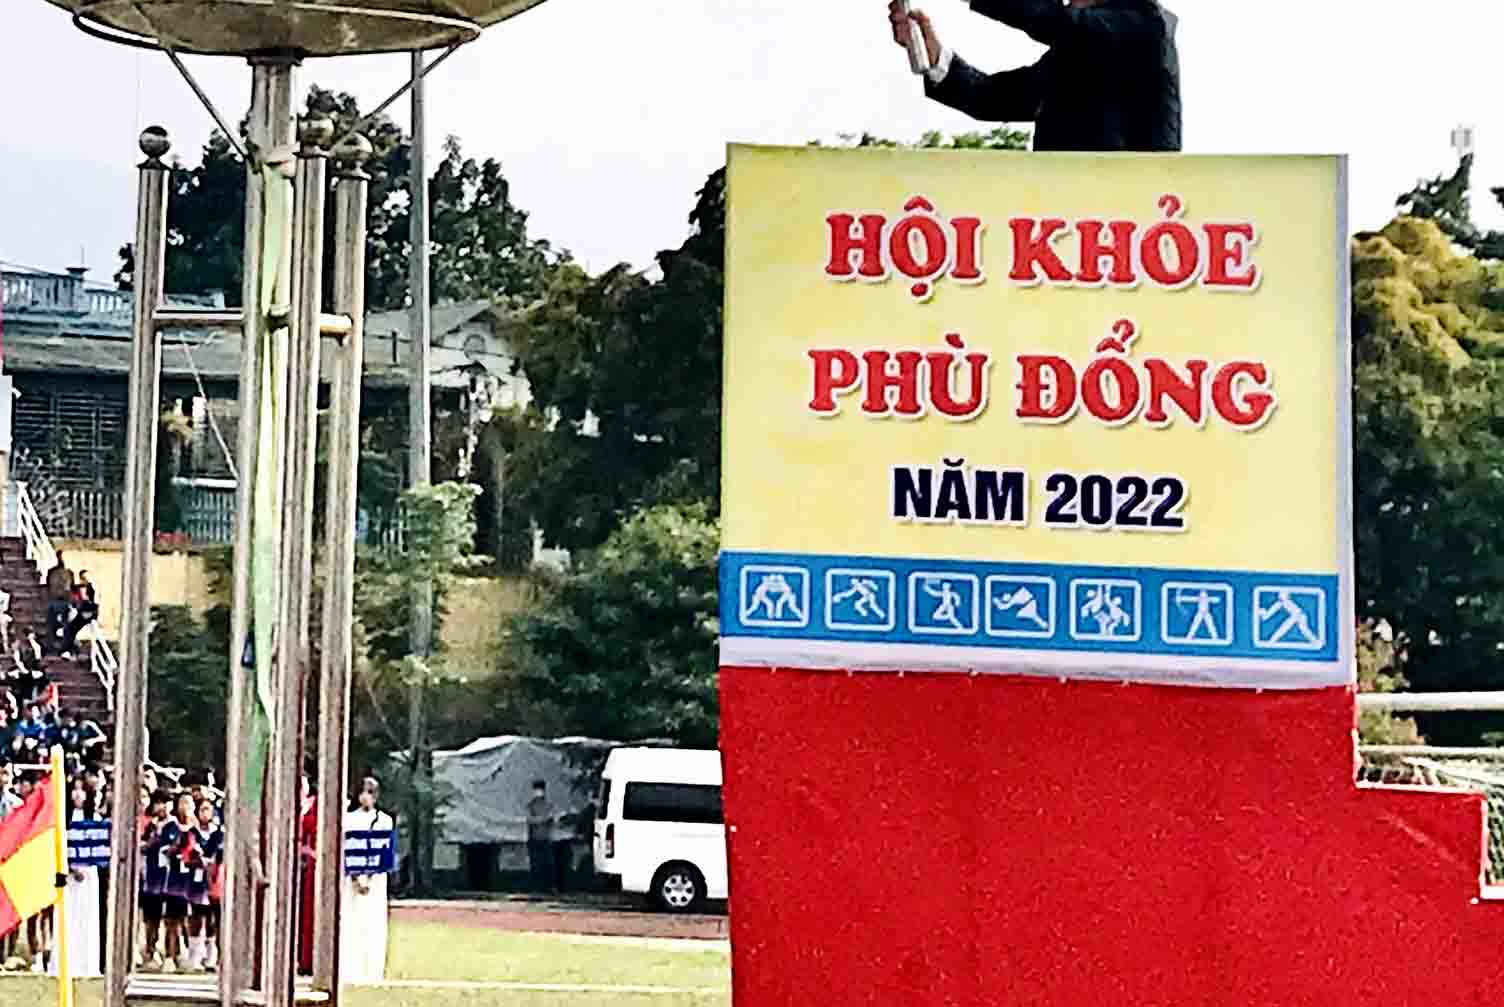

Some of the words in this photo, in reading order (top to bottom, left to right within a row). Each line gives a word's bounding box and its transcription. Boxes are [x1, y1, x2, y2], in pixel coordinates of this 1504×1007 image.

[824, 195, 982, 299] HỘI
[1008, 194, 1258, 289] KHỎE
[807, 333, 988, 418] PHÙ
[1015, 319, 1275, 427] ĐỔNG
[892, 456, 1025, 523] NĂM
[1045, 473, 1186, 530] 2022
